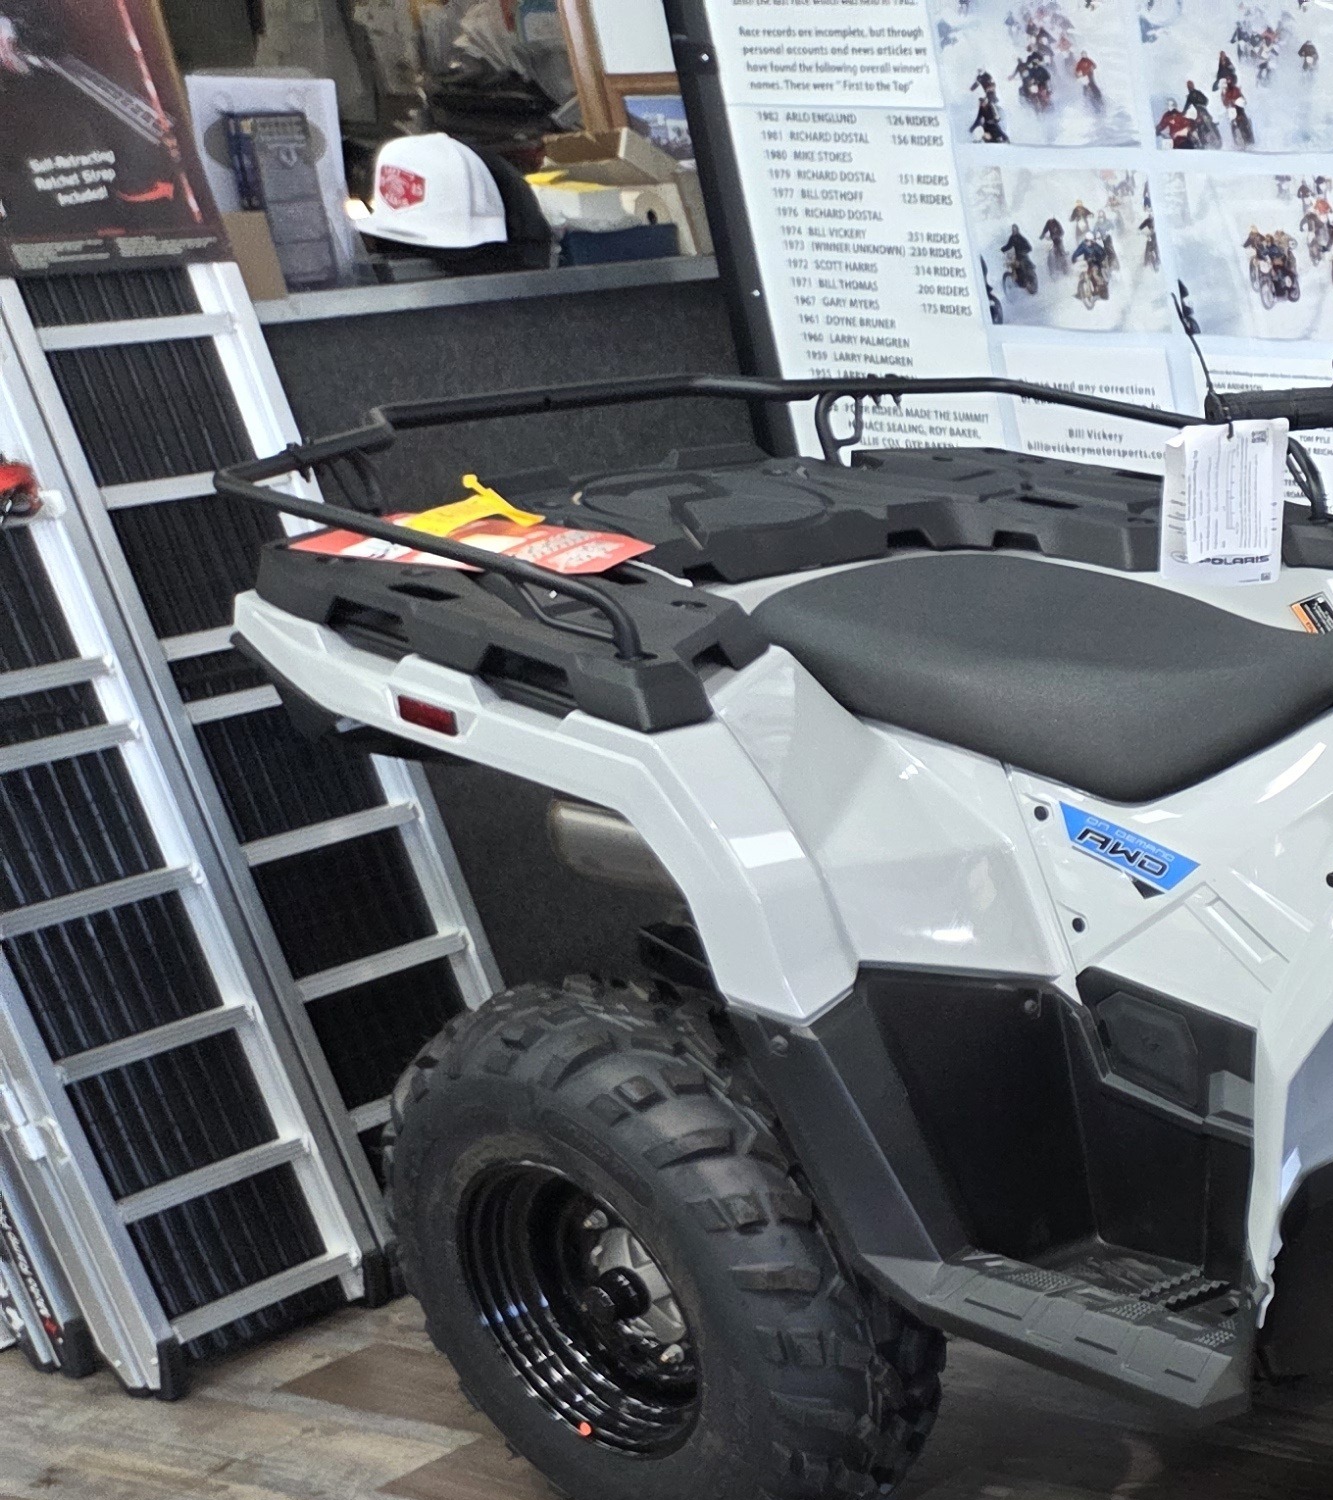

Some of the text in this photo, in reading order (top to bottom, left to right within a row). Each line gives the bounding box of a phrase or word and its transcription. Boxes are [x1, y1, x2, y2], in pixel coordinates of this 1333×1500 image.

[763, 26, 796, 38] records
[887, 26, 923, 41] through
[787, 45, 828, 56] accounts
[831, 45, 849, 56] and
[852, 46, 874, 56] news
[799, 62, 814, 73] the
[906, 116, 940, 127] RIDERS
[789, 131, 832, 143] RICHARD
[834, 132, 869, 144] DOSTAL
[910, 136, 944, 147] RIDERS
[818, 151, 853, 163] STOKES
[797, 170, 838, 181] RICHARD
[840, 171, 876, 183] DOSTAL
[917, 174, 949, 186] RIDERS
[801, 189, 818, 200] BILL
[920, 194, 953, 206] RIDERS
[804, 208, 846, 219] RICHARD
[848, 209, 884, 221] DOSTAL
[808, 226, 826, 237] BILL
[829, 228, 867, 239] VICKERY
[926, 232, 959, 244] RIDERS
[930, 247, 963, 260] RIDERS
[814, 260, 842, 271] SCOTT
[844, 261, 878, 273] HARRIS
[934, 266, 967, 278] RIDERS
[840, 279, 878, 292] THOMAS
[937, 285, 969, 297] RIDERS
[850, 298, 880, 310] MYERS
[940, 304, 972, 316] RIDERS
[859, 317, 896, 329] BRUNER
[829, 333, 858, 345] LARRY
[860, 335, 910, 348] PALMGREN
[834, 352, 862, 363] LARRY
[863, 353, 914, 366] PALMGREN
[1099, 384, 1155, 396] corrections
[906, 408, 930, 418] MADE
[934, 410, 949, 420] THE
[953, 411, 989, 423] SUMMIT
[929, 424, 948, 434] ROY
[1069, 428, 1123, 443] Bill Vickery
[1027, 441, 1165, 460] bill@vickerymotorsports.co
[1199, 555, 1270, 566] POLARIS
[1077, 827, 1168, 877] AWD
